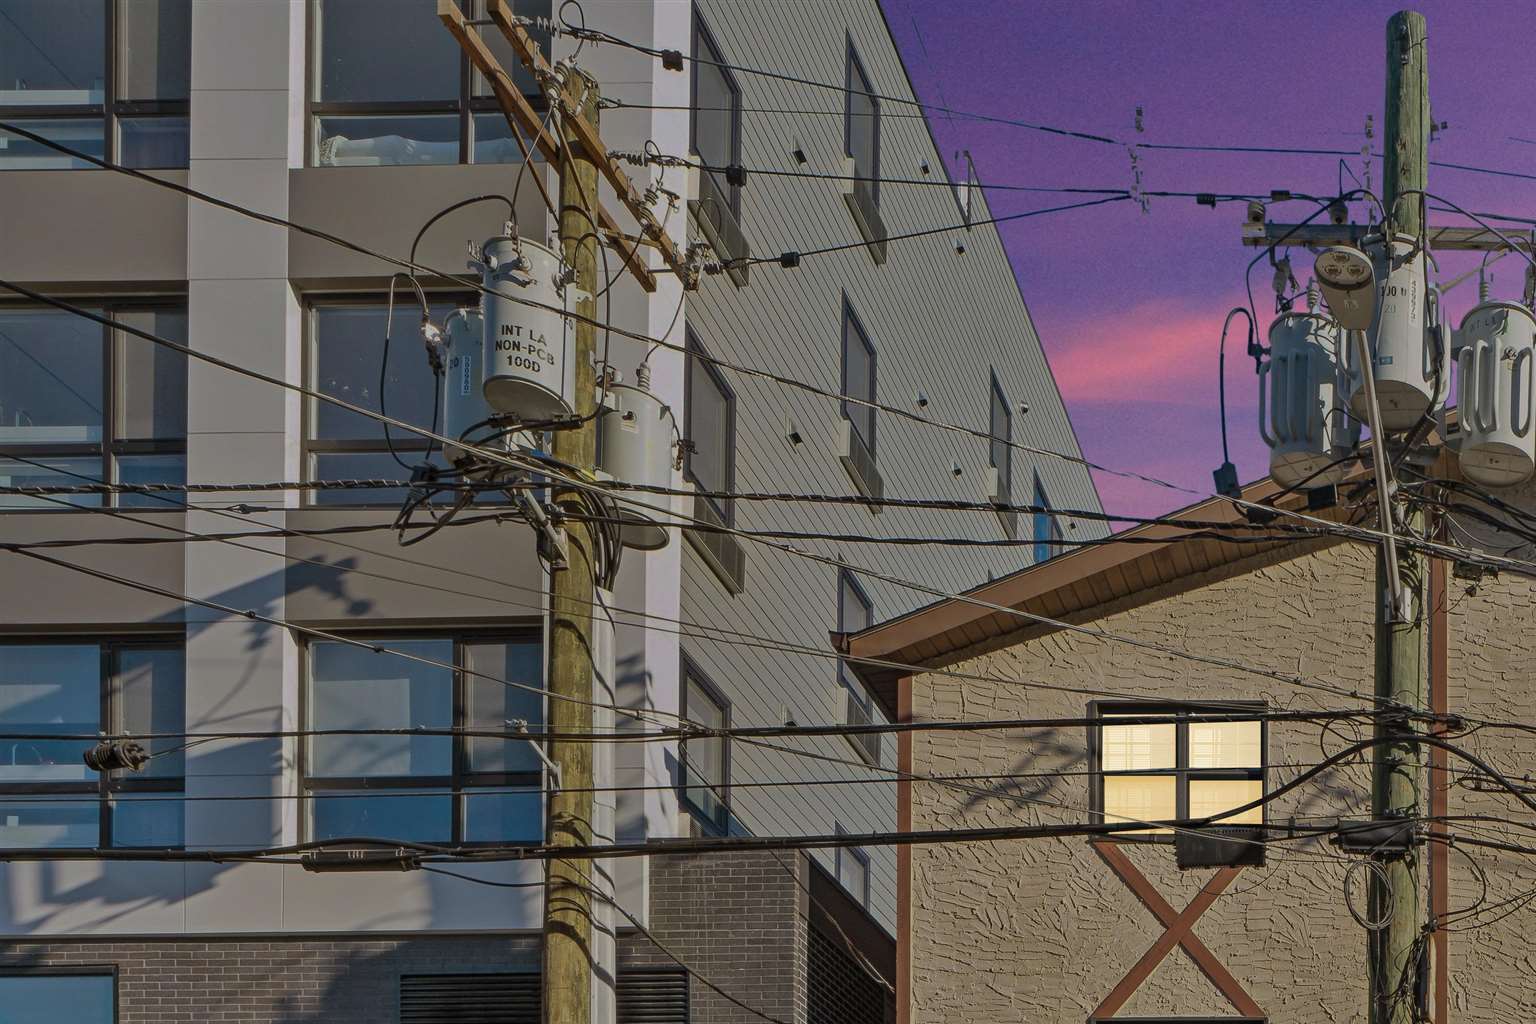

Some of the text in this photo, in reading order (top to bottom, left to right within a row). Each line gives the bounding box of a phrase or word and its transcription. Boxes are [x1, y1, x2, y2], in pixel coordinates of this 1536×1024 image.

[501, 324, 547, 346] INT LA
[495, 339, 555, 365] NON-PCB
[507, 355, 541, 373] 100D
